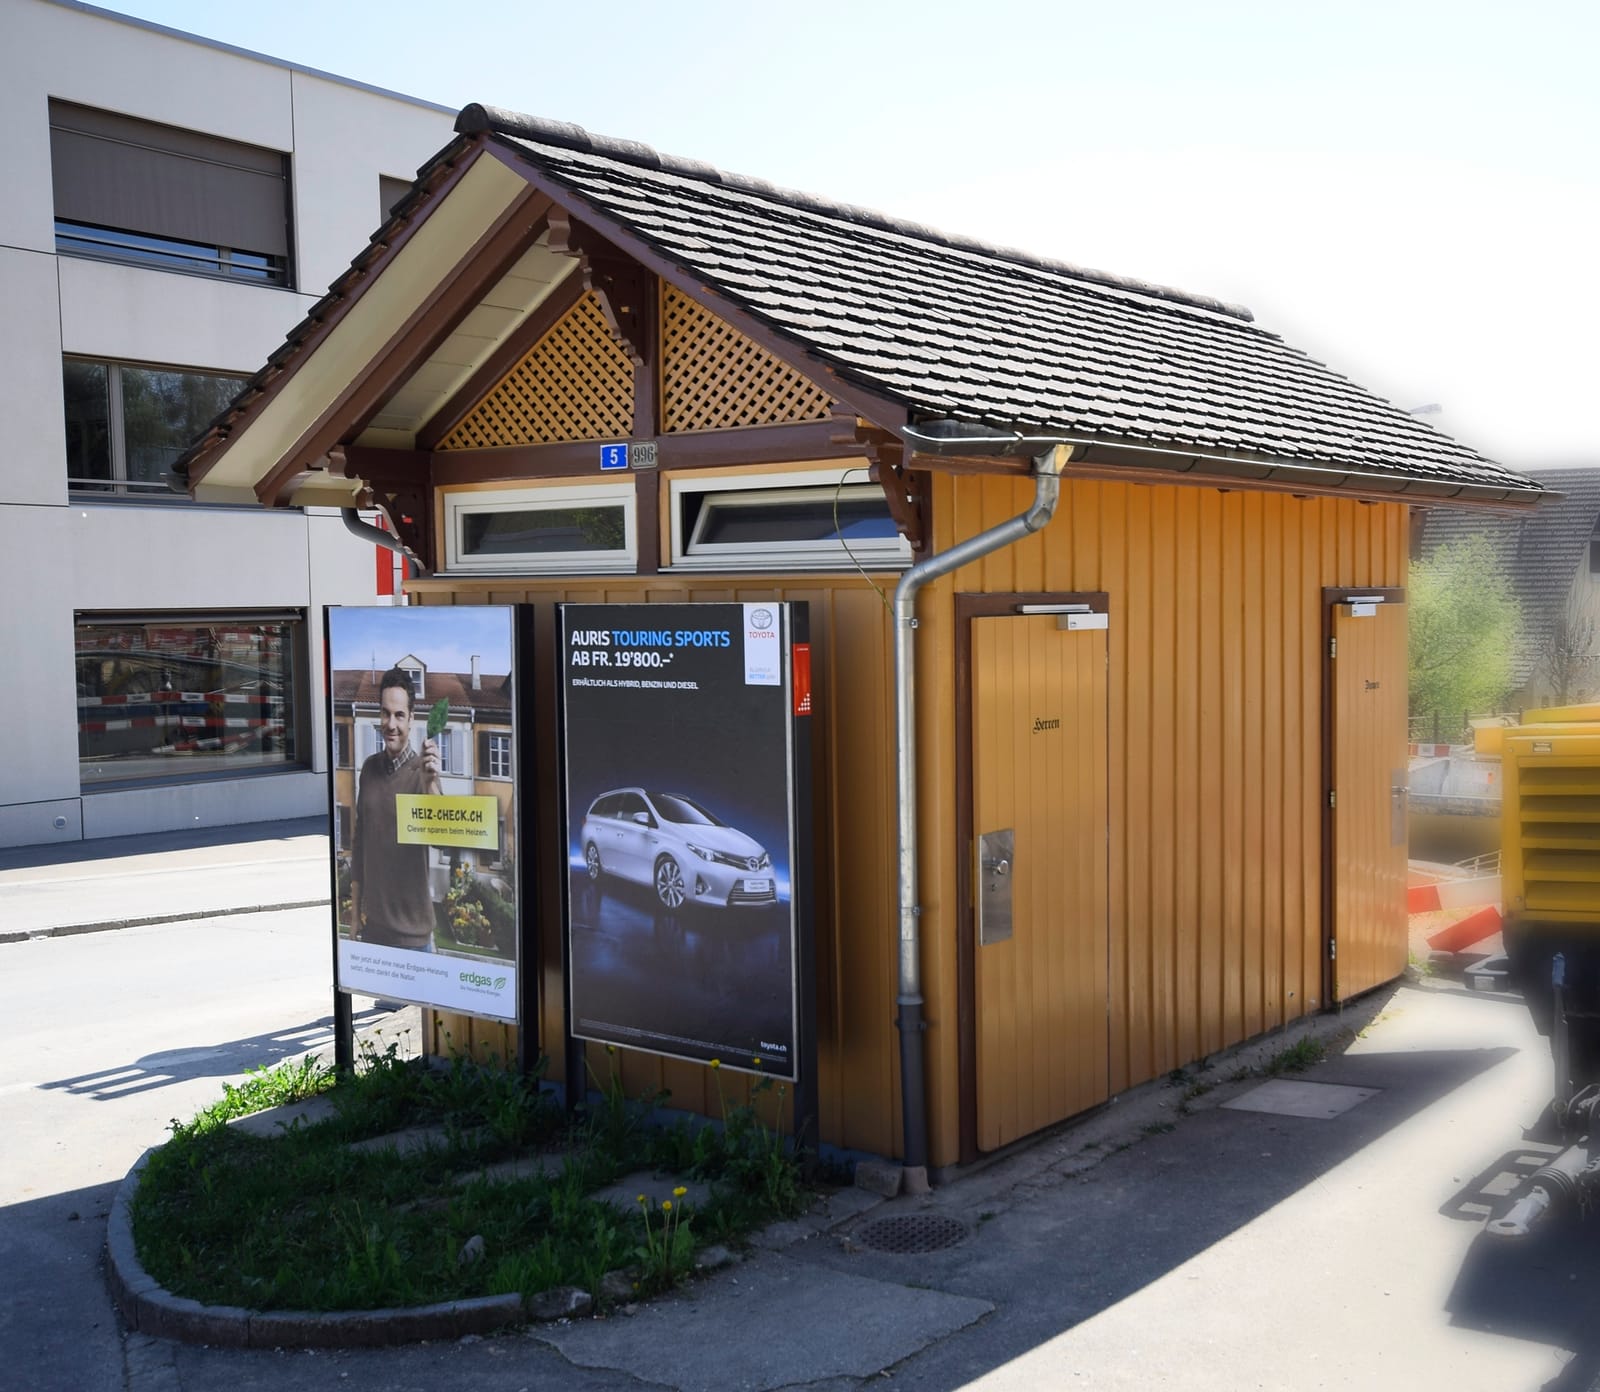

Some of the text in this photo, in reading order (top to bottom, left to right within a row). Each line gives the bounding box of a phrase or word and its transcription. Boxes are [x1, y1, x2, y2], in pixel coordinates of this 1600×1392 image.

[610, 448, 618, 465] 5
[634, 446, 654, 464] 996
[571, 630, 731, 648] AURIS TOURING SPORTS
[748, 631, 775, 639] TOYOTA
[571, 650, 590, 667] AB
[592, 651, 613, 667] FR.
[572, 677, 606, 687] ERHÄLTLICH
[607, 679, 618, 687] ALS
[618, 679, 641, 689] HYBRID,
[641, 680, 663, 689] BENZIN
[663, 681, 677, 689] UND
[1032, 717, 1060, 735] Herren
[411, 807, 483, 823] HEIZ-CHECK.CH
[407, 824, 489, 837] Clever sparen beim Heizen.
[459, 971, 492, 987] erdgas
[760, 1041, 787, 1052] toyota.ch
